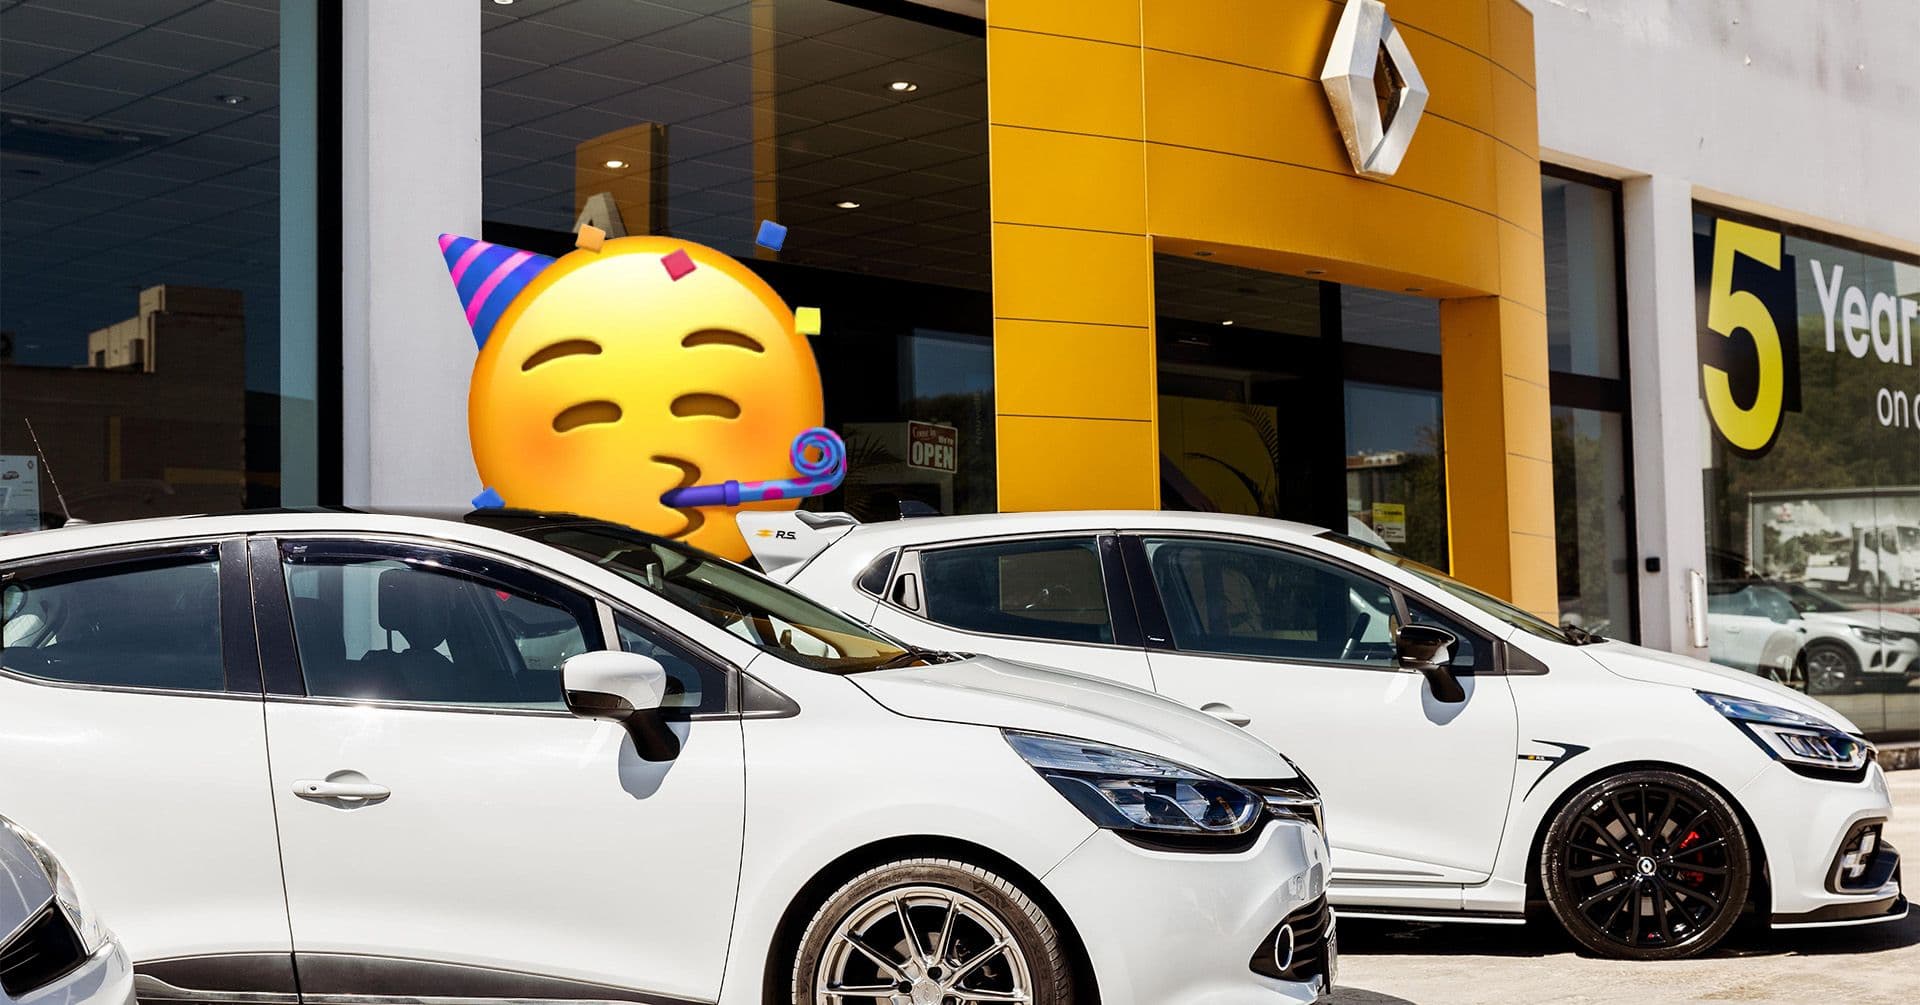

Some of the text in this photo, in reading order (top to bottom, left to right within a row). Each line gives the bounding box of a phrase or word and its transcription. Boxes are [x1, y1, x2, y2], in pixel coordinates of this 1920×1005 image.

[1703, 218, 1784, 451] 5
[1876, 387, 1909, 429] on
[912, 441, 954, 470] OPEN
